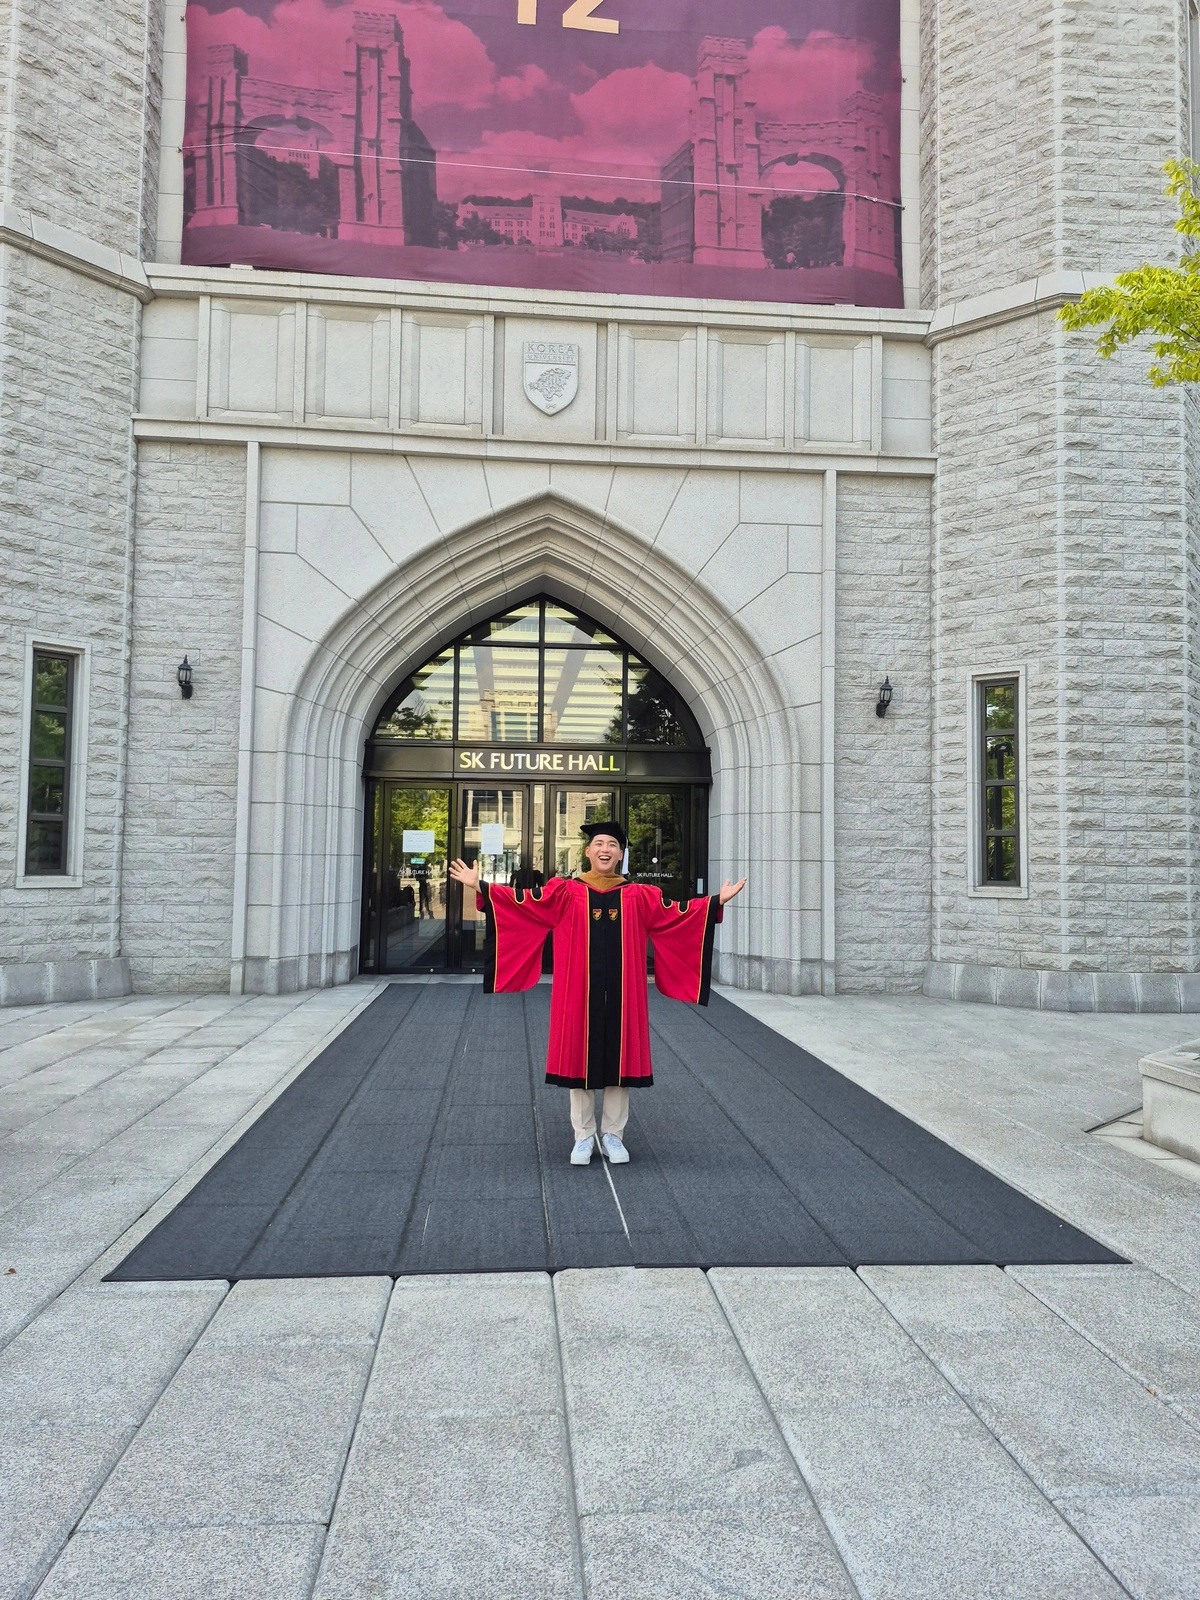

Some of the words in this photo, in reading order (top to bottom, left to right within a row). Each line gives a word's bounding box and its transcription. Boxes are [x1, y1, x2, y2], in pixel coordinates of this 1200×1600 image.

[528, 343, 574, 354] KOREA
[460, 752, 486, 769] SK
[490, 753, 564, 770] FUTURE
[568, 754, 621, 771] HALL
